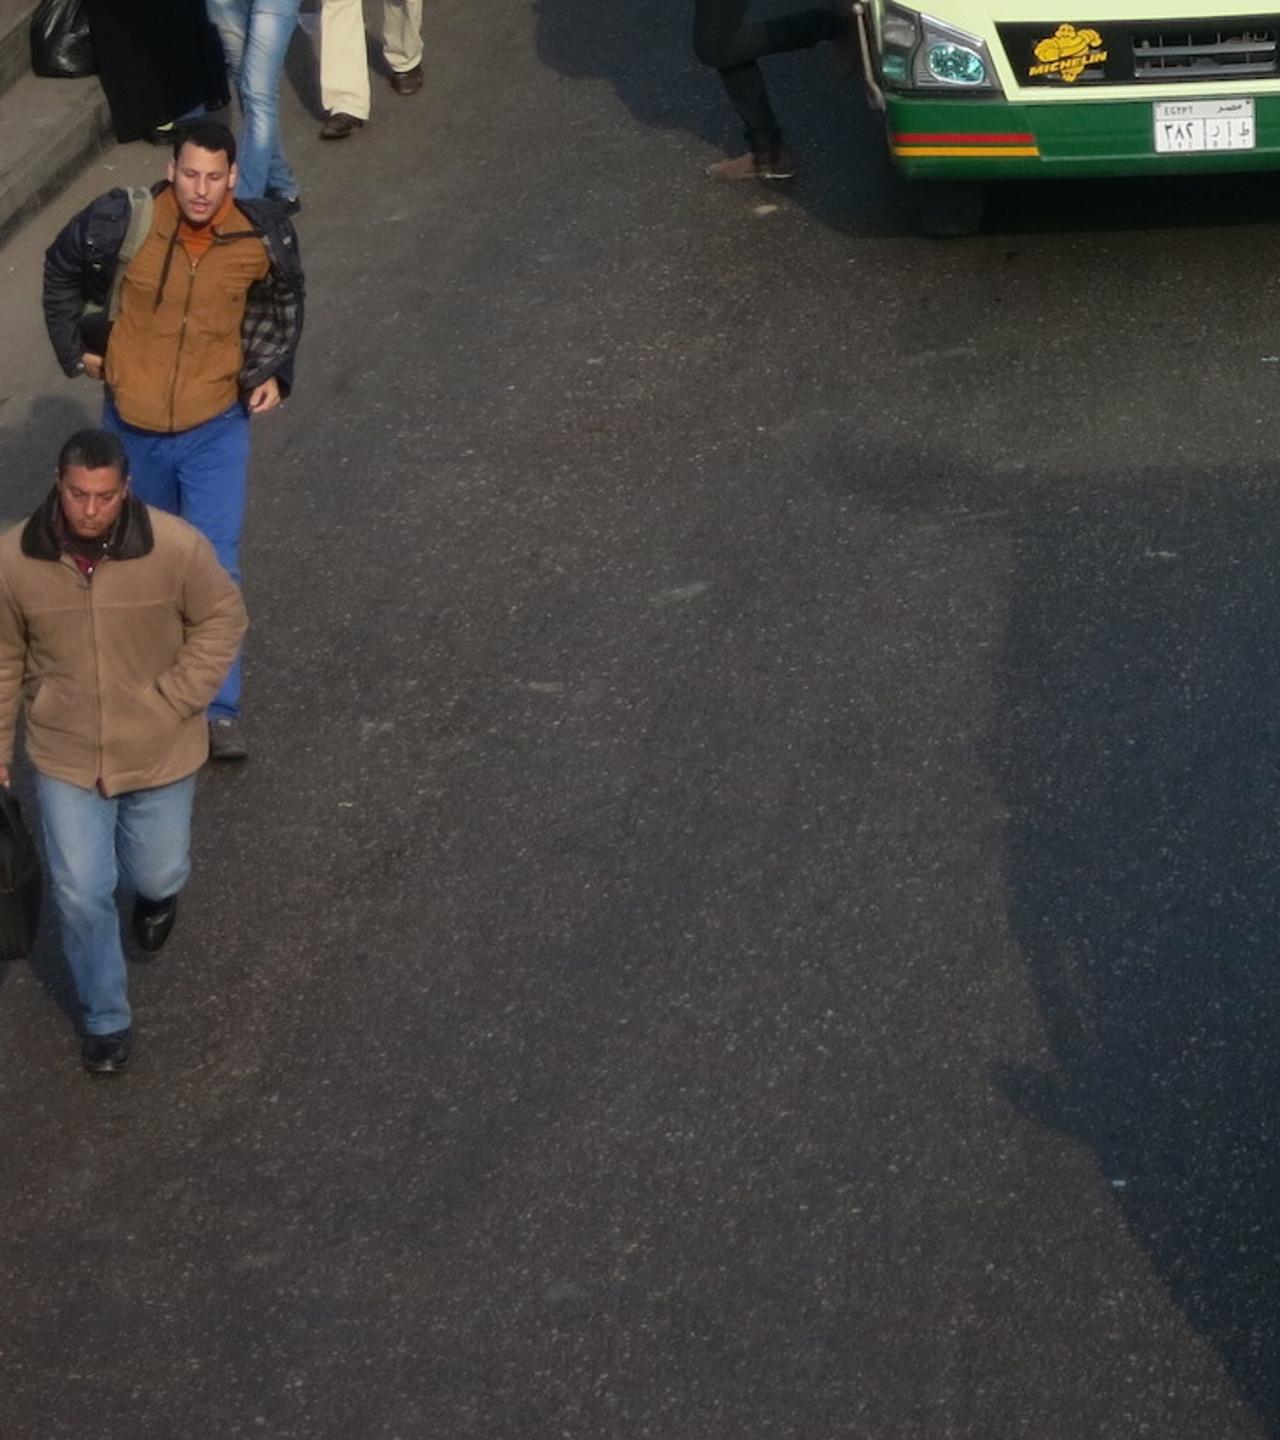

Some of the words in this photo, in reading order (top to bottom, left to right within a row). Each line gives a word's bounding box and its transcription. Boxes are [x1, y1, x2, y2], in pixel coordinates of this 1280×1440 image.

[1029, 51, 1108, 76] MICHELIN
[1217, 104, 1243, 113] مصر
[1164, 122, 1194, 140] ٣٨٢
